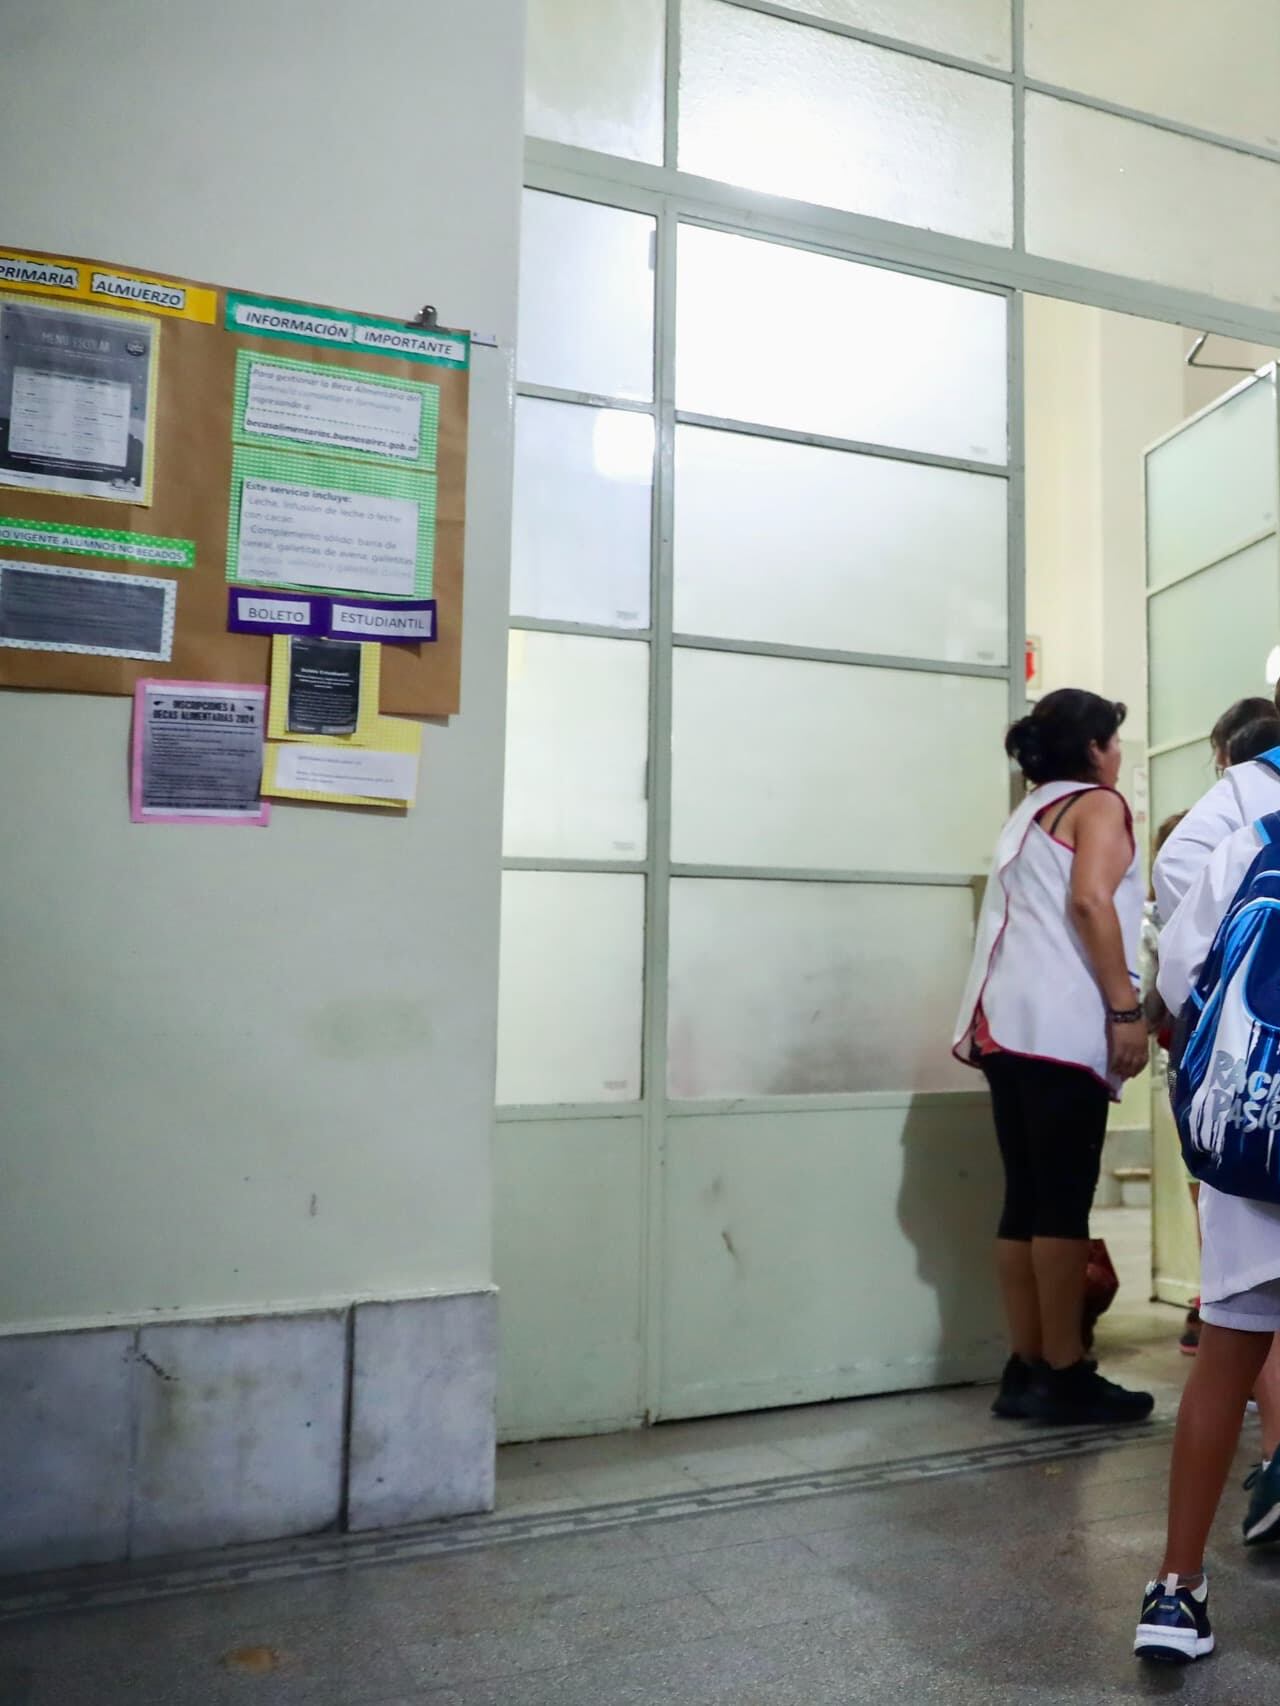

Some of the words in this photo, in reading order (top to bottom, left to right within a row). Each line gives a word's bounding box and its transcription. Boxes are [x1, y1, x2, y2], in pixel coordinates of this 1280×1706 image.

[96, 280, 181, 306] ALMUERZO
[246, 311, 348, 338] INFORMACIÓN
[364, 330, 453, 355] IMPORTANTE
[246, 481, 267, 492] Este
[270, 485, 309, 498] servicio
[312, 490, 352, 504] incluye:
[14, 531, 60, 545] VIGENTE
[62, 537, 117, 551] ALUMNOS
[248, 607, 304, 623] BOLETO
[341, 612, 425, 630] ESTUDIANTIL
